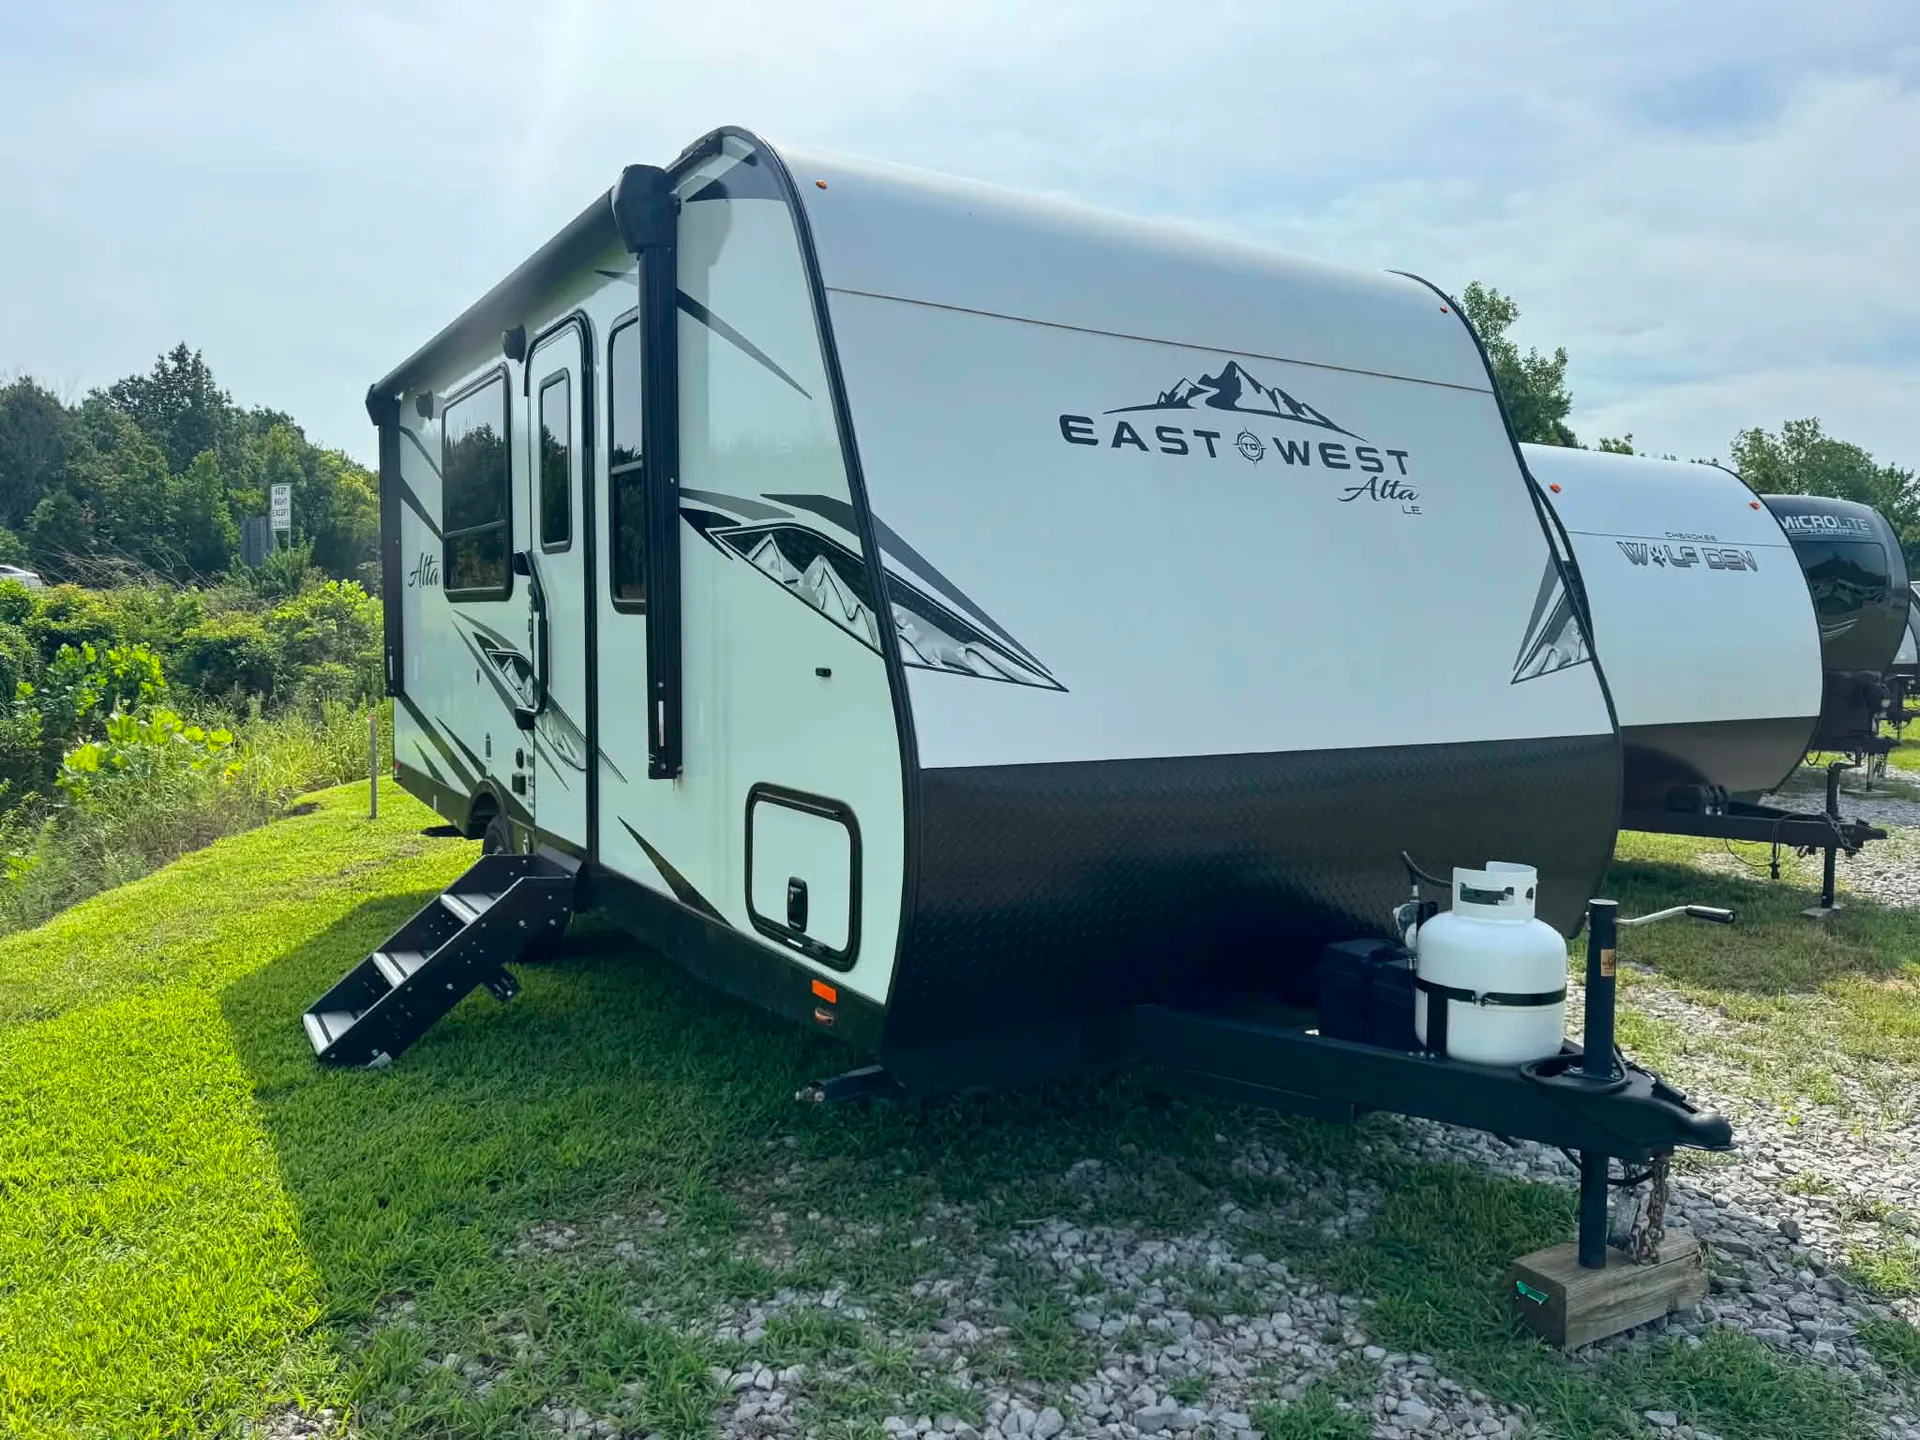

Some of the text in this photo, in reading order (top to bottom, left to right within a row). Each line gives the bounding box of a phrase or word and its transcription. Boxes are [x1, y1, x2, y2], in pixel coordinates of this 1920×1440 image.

[1059, 414, 1221, 458] EAST
[1272, 437, 1409, 475] WEST
[1336, 476, 1421, 502] Alta
[1401, 504, 1423, 515] LE
[1664, 531, 1718, 541] CHEROKEE
[408, 552, 441, 588] Alta
[1701, 547, 1758, 572] DEN
